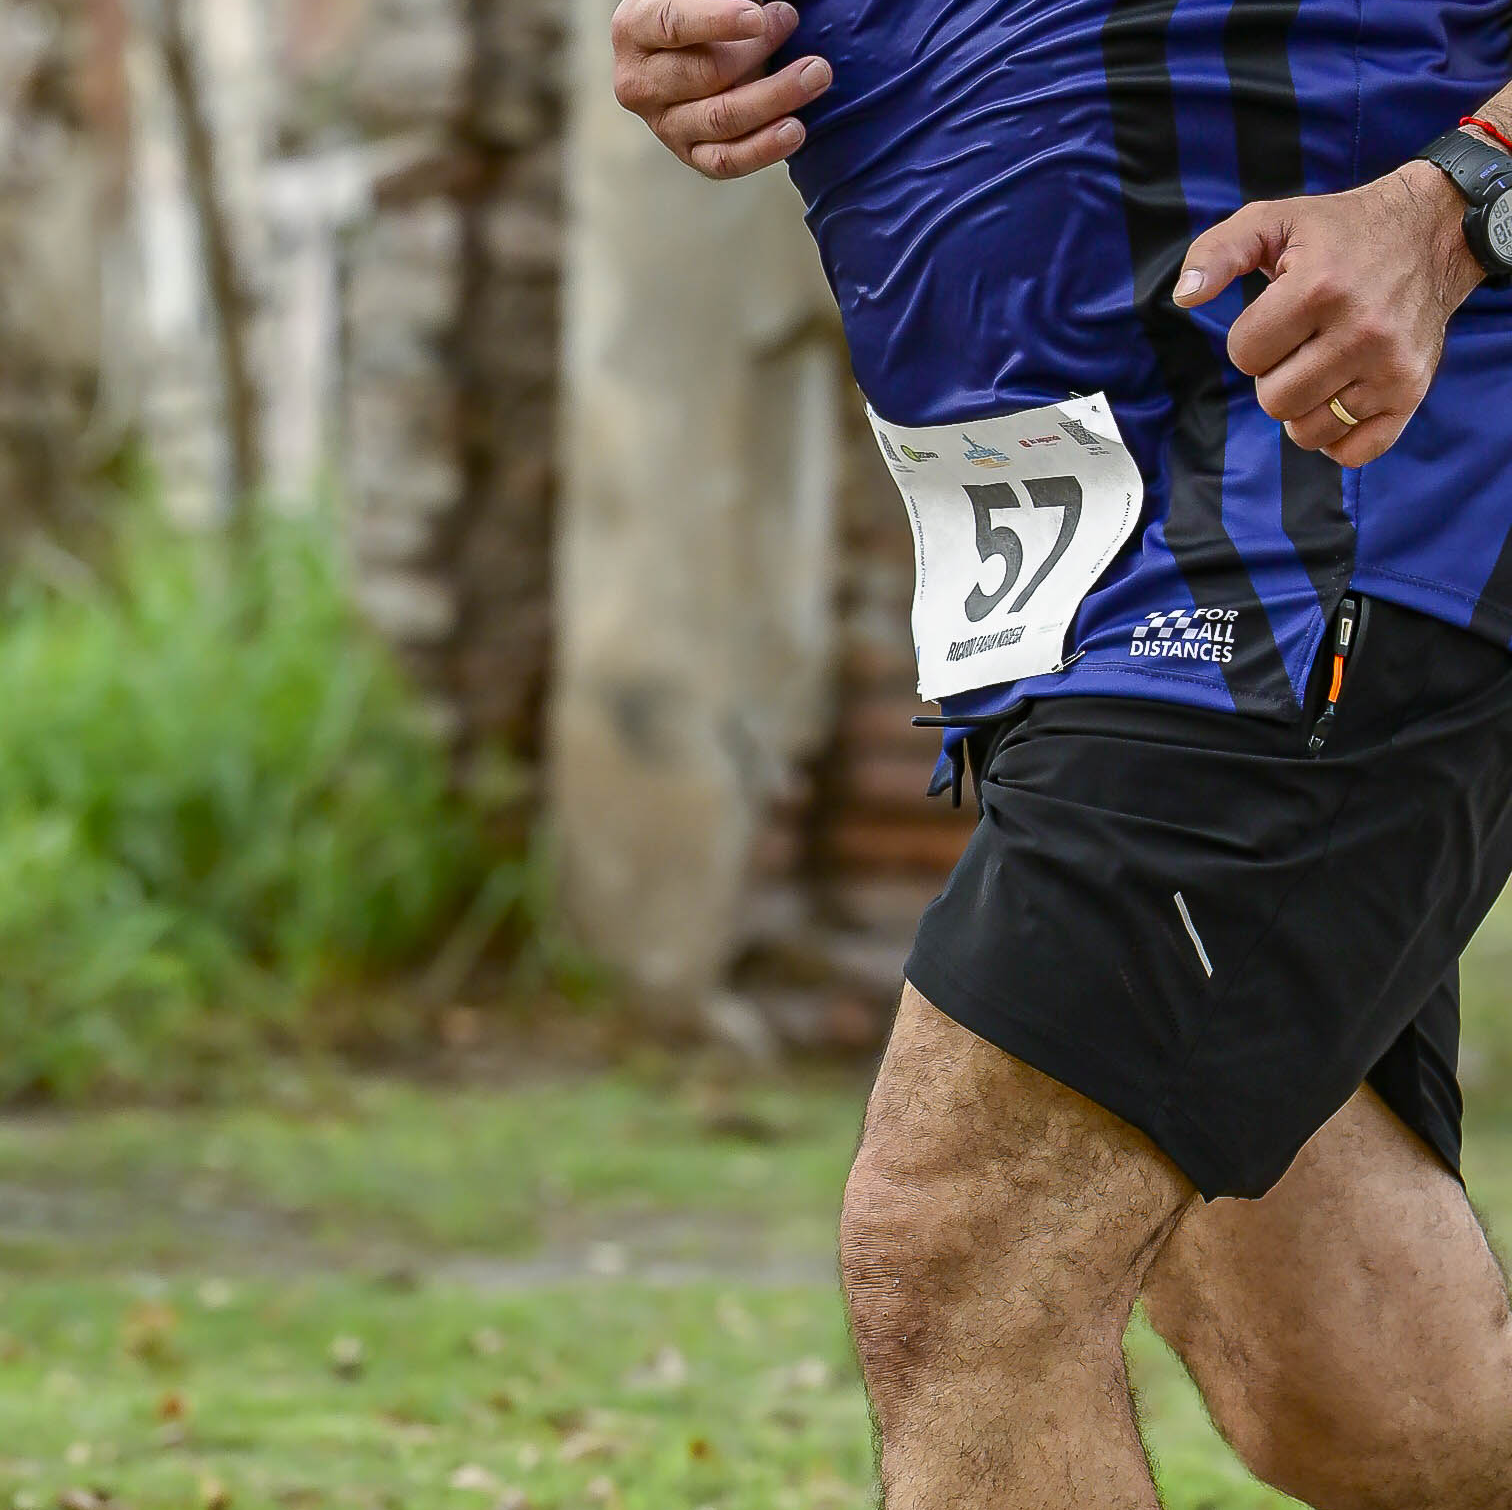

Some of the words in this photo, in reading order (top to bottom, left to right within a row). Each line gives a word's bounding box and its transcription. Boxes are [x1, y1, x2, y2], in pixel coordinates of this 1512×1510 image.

[961, 476, 1083, 623] 57
[1192, 608, 1239, 622] FOR
[1196, 623, 1235, 643] ALL
[1129, 640, 1233, 663] DISTANCES
